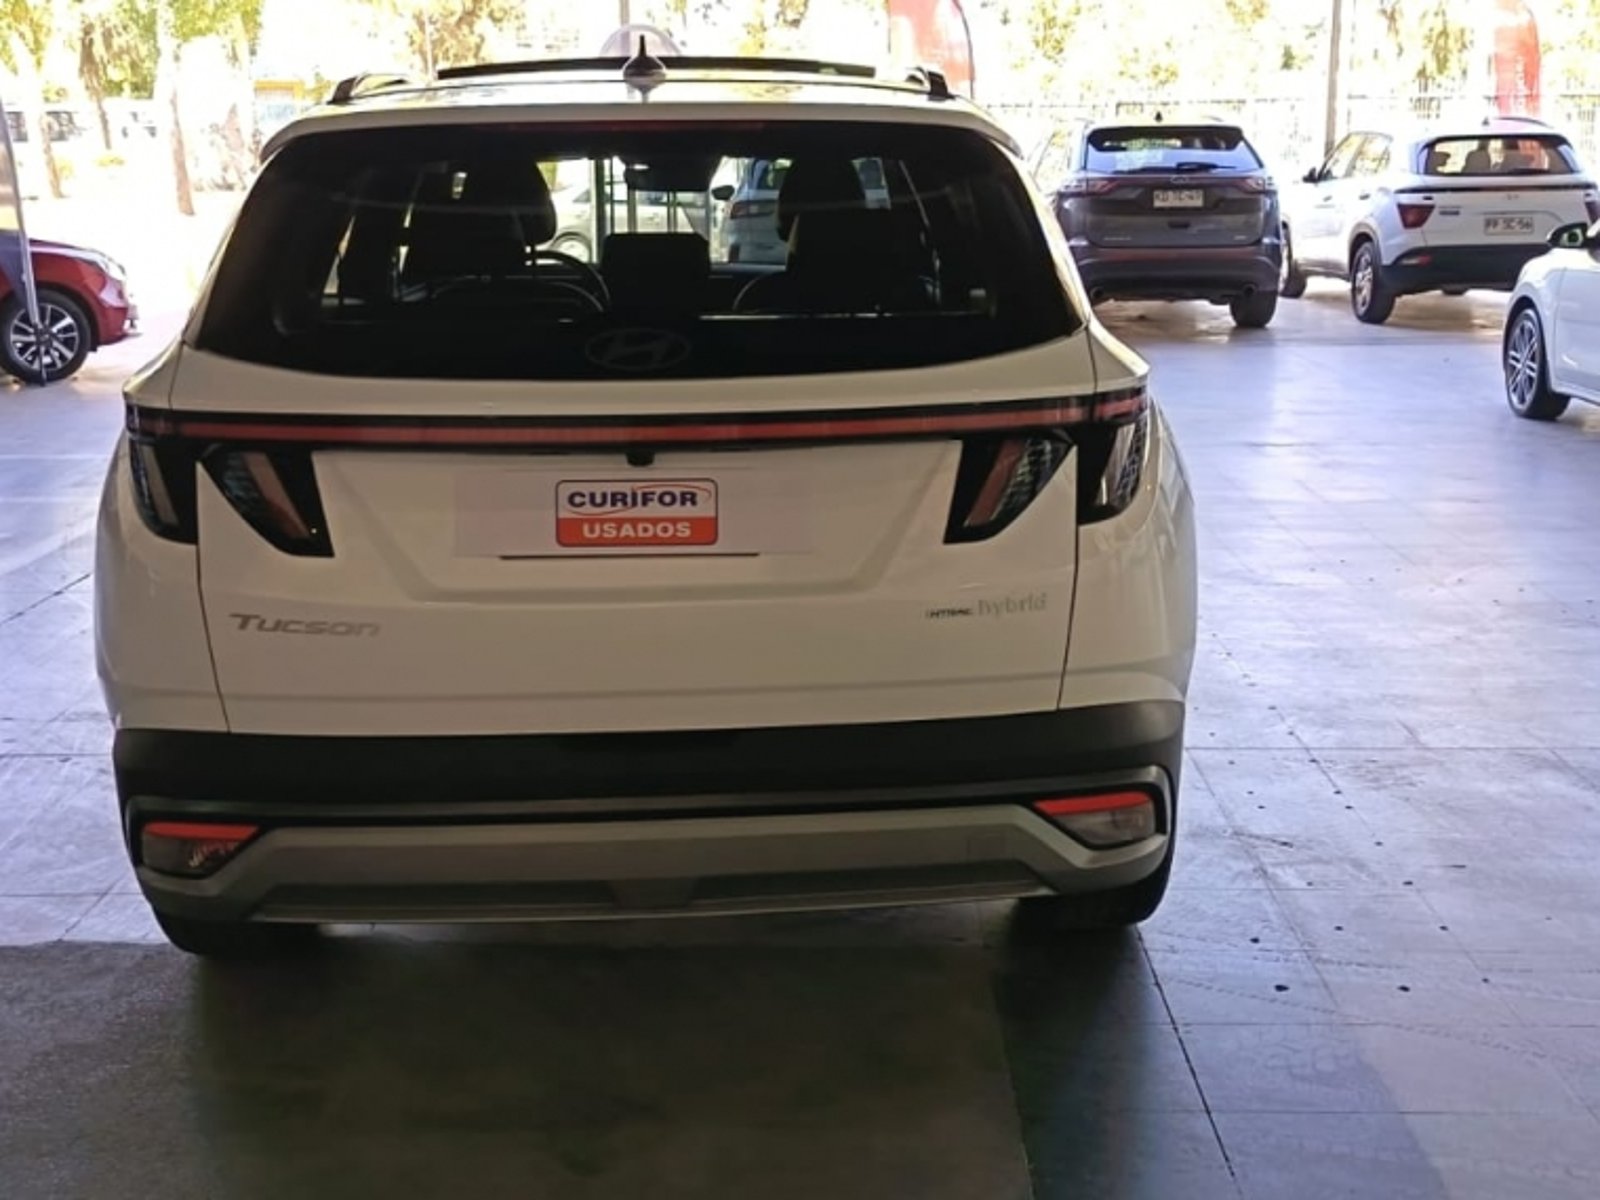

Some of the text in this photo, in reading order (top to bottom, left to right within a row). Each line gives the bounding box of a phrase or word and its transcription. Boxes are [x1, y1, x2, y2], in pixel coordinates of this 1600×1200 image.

[567, 490, 698, 508] CURIFOR
[582, 521, 692, 539] USADOS
[978, 592, 1047, 618] hybrid
